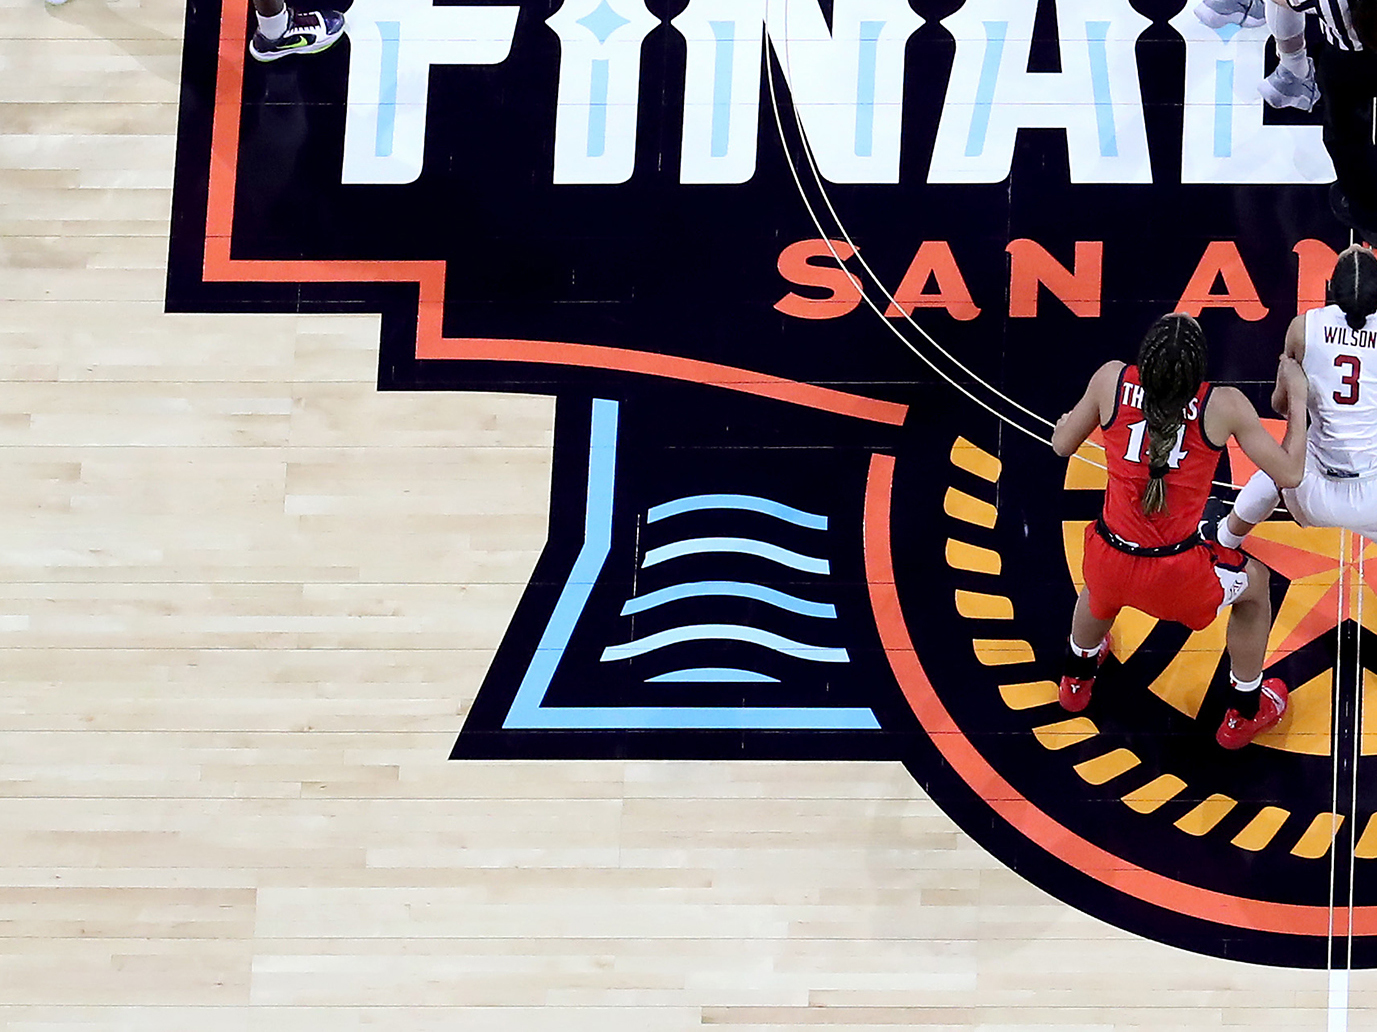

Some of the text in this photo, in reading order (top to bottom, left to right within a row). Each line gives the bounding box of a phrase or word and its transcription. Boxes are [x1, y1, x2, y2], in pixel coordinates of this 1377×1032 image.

[773, 238, 1103, 321] SAN
[1323, 325, 1377, 349] WILSON
[1121, 381, 1200, 421] THS
[1332, 354, 1361, 405] 3
[1123, 419, 1189, 469] 14
